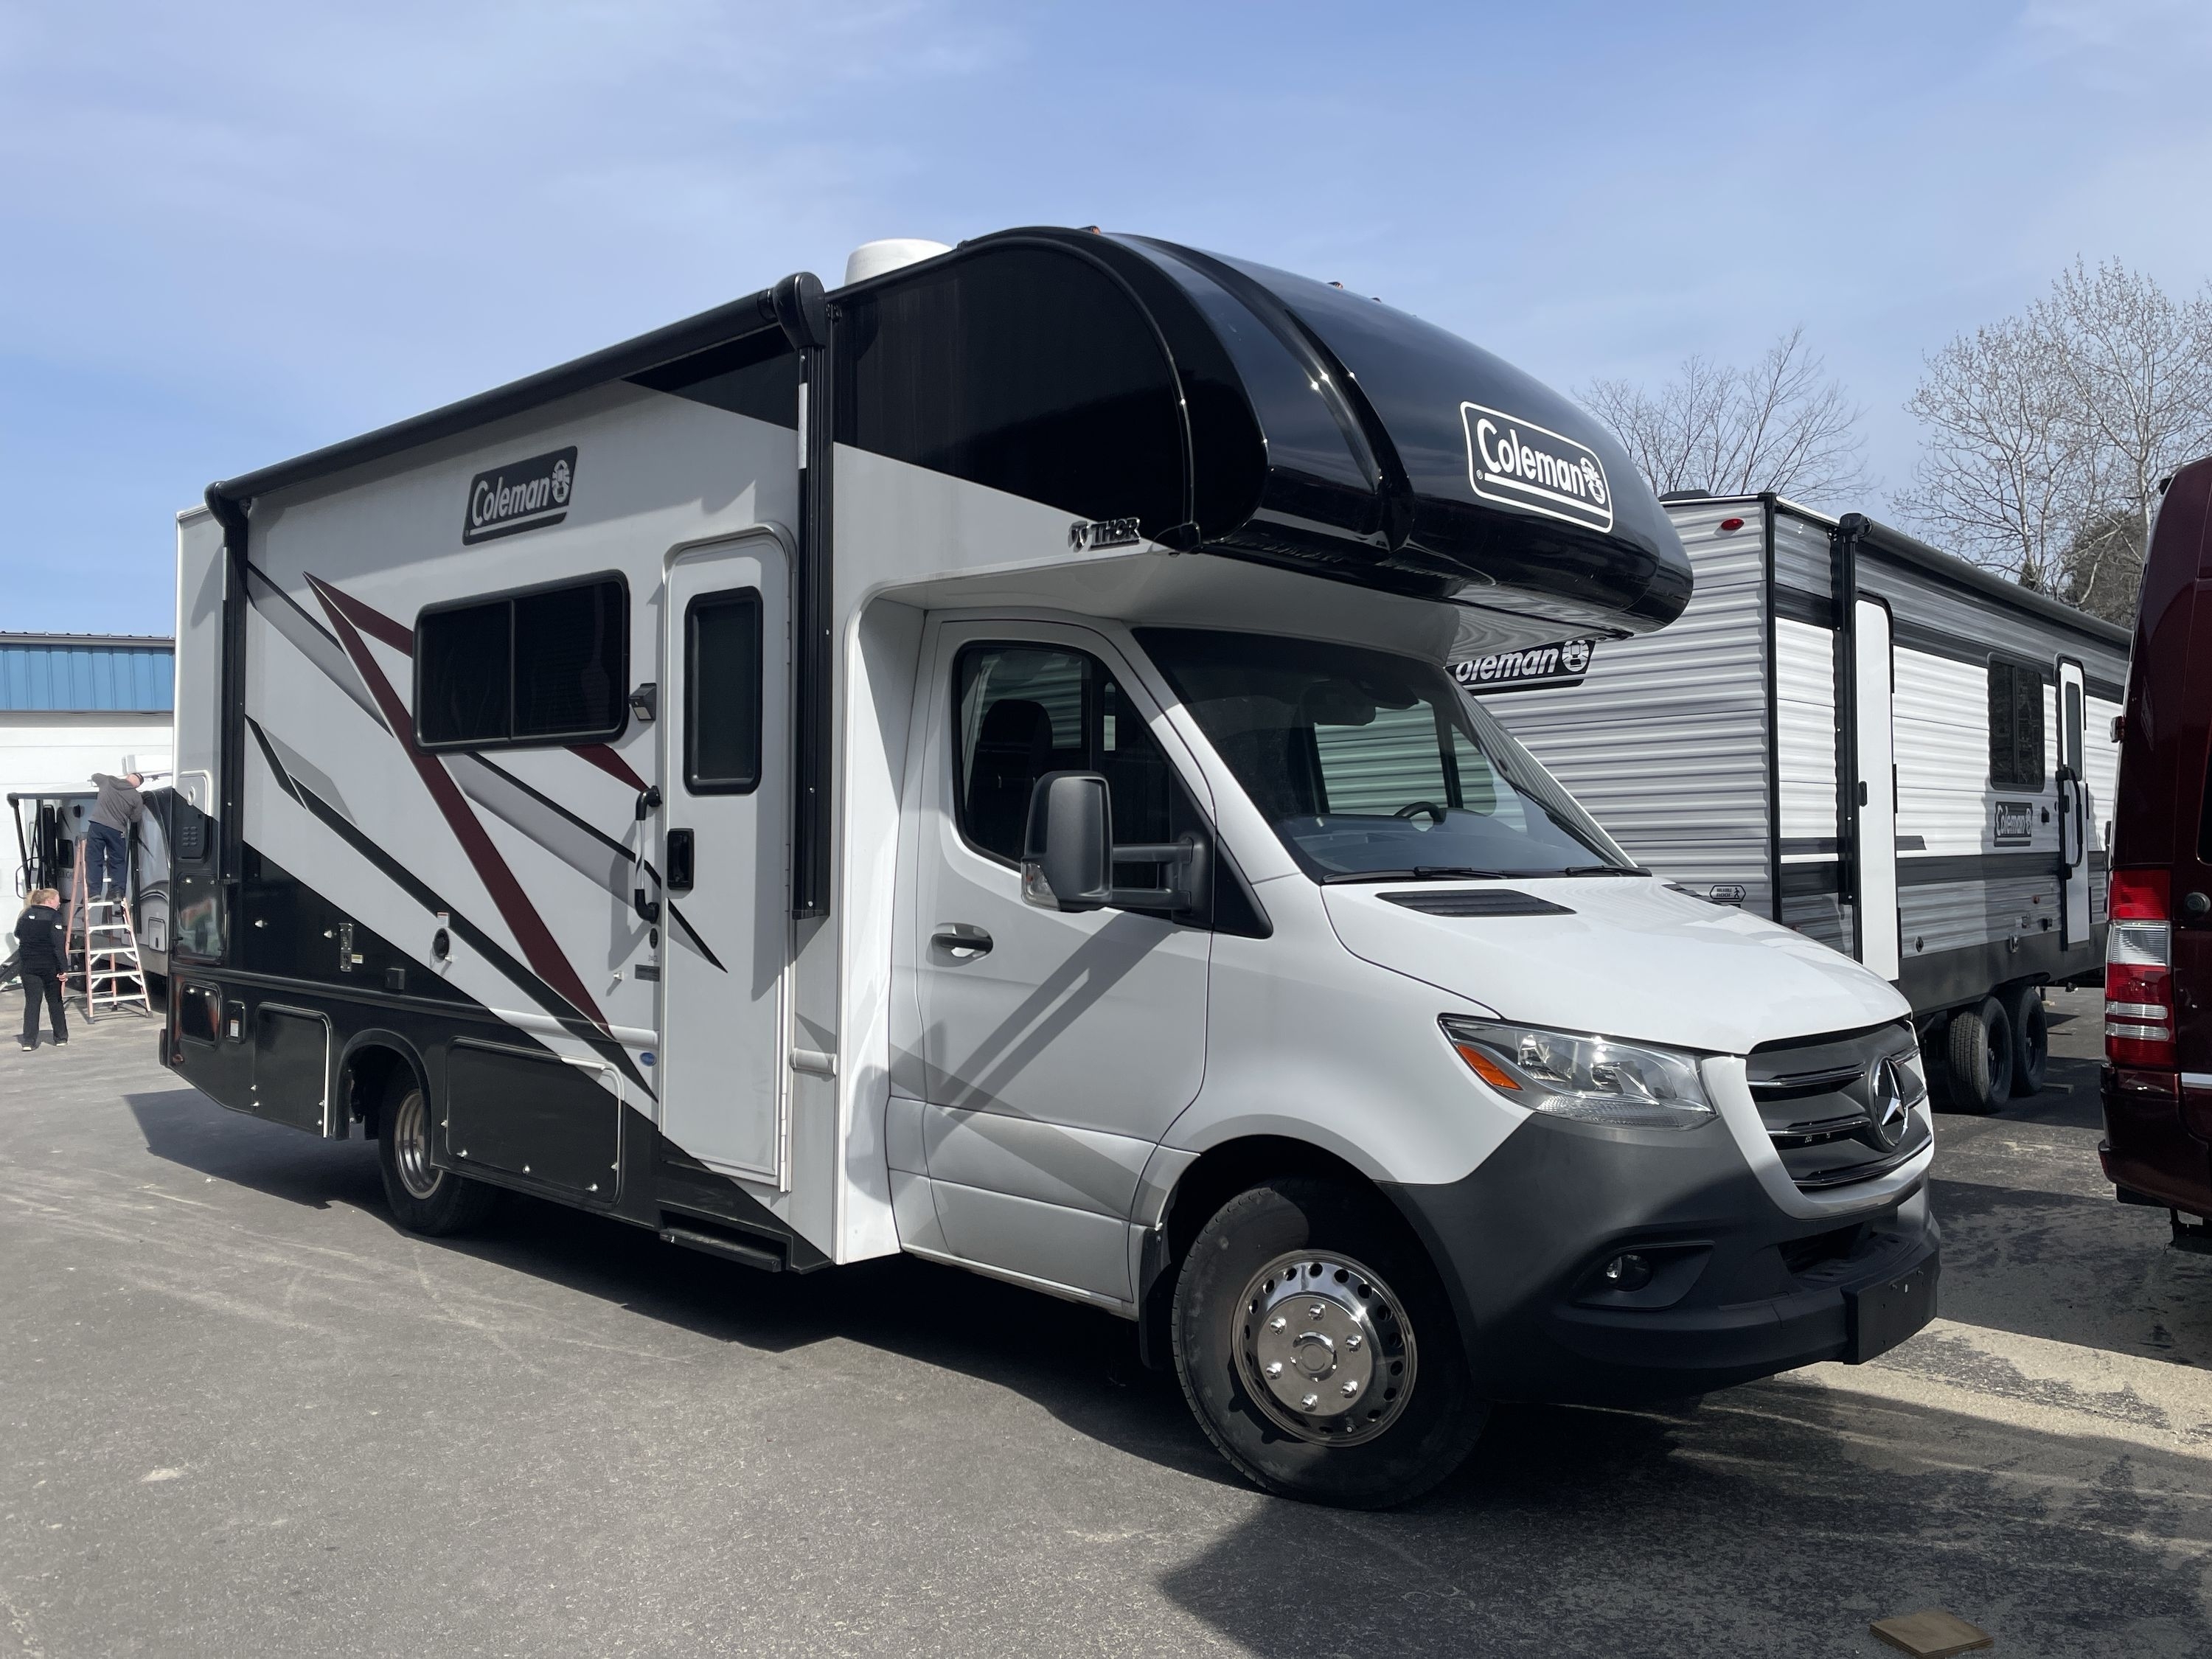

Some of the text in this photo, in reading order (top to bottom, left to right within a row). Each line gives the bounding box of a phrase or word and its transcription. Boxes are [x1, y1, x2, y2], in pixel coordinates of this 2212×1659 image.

[1477, 418, 1586, 497] Coleman
[471, 476, 550, 526] Coleman
[1090, 517, 1141, 546] THOR
[1455, 647, 1559, 682] oleman
[1996, 804, 2025, 836] Coleman
